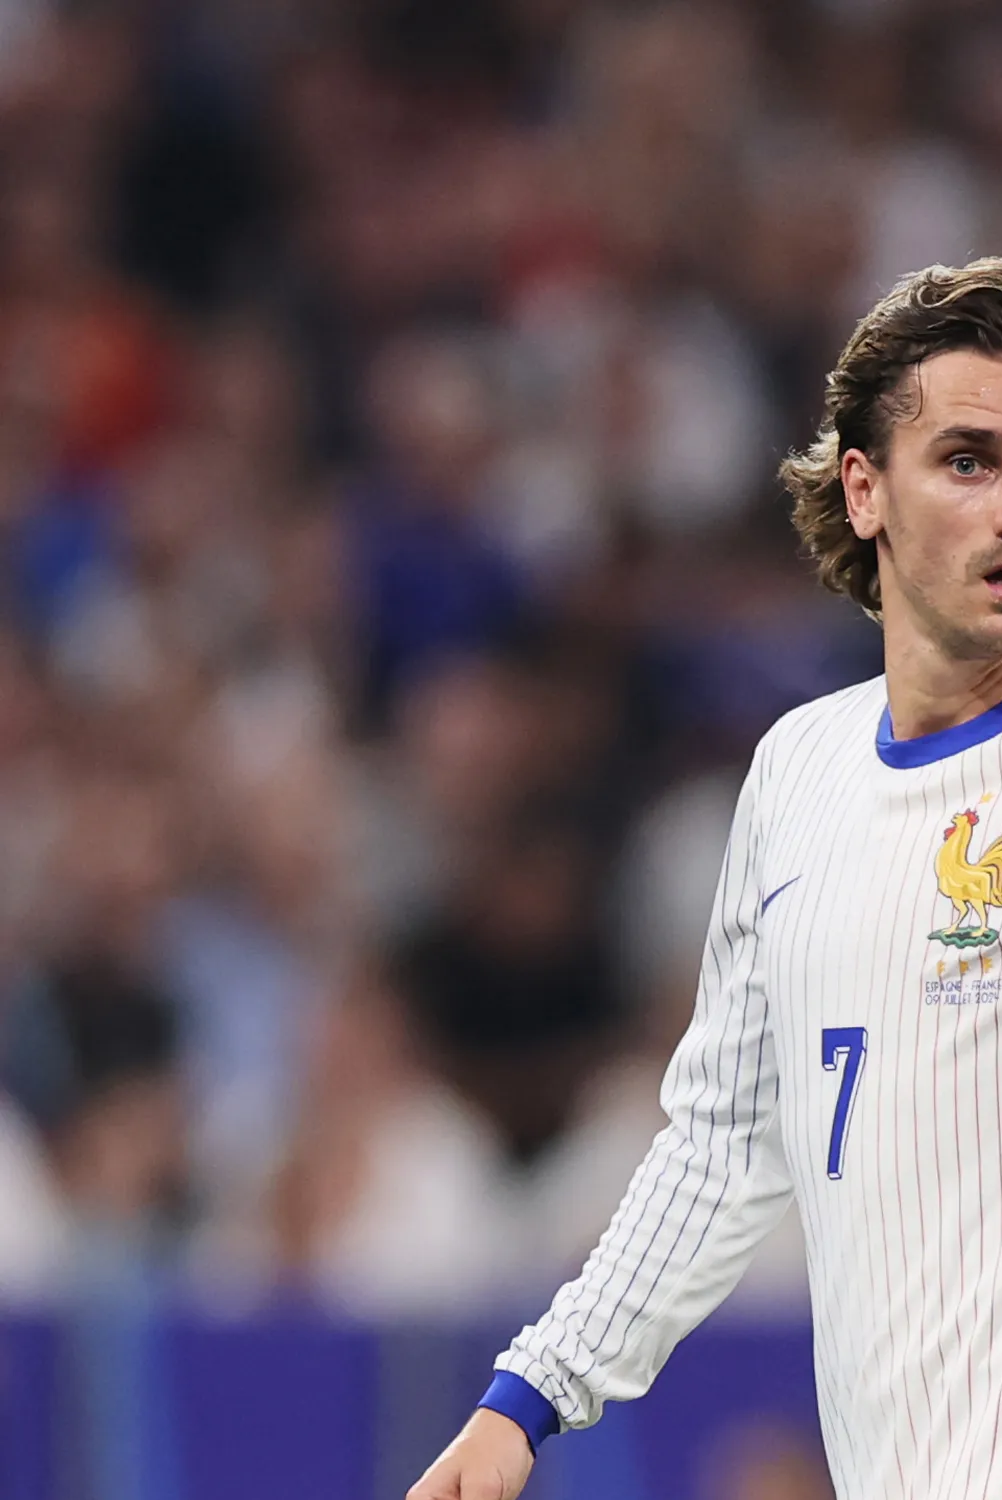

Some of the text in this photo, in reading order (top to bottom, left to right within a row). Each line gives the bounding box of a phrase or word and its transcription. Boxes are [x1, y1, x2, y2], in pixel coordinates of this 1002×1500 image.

[925, 980, 961, 992] ESPAGNE
[971, 978, 1001, 991] FRANCE
[925, 991, 999, 1005] 09 JUILLET 2024
[821, 1027, 868, 1180] 7
